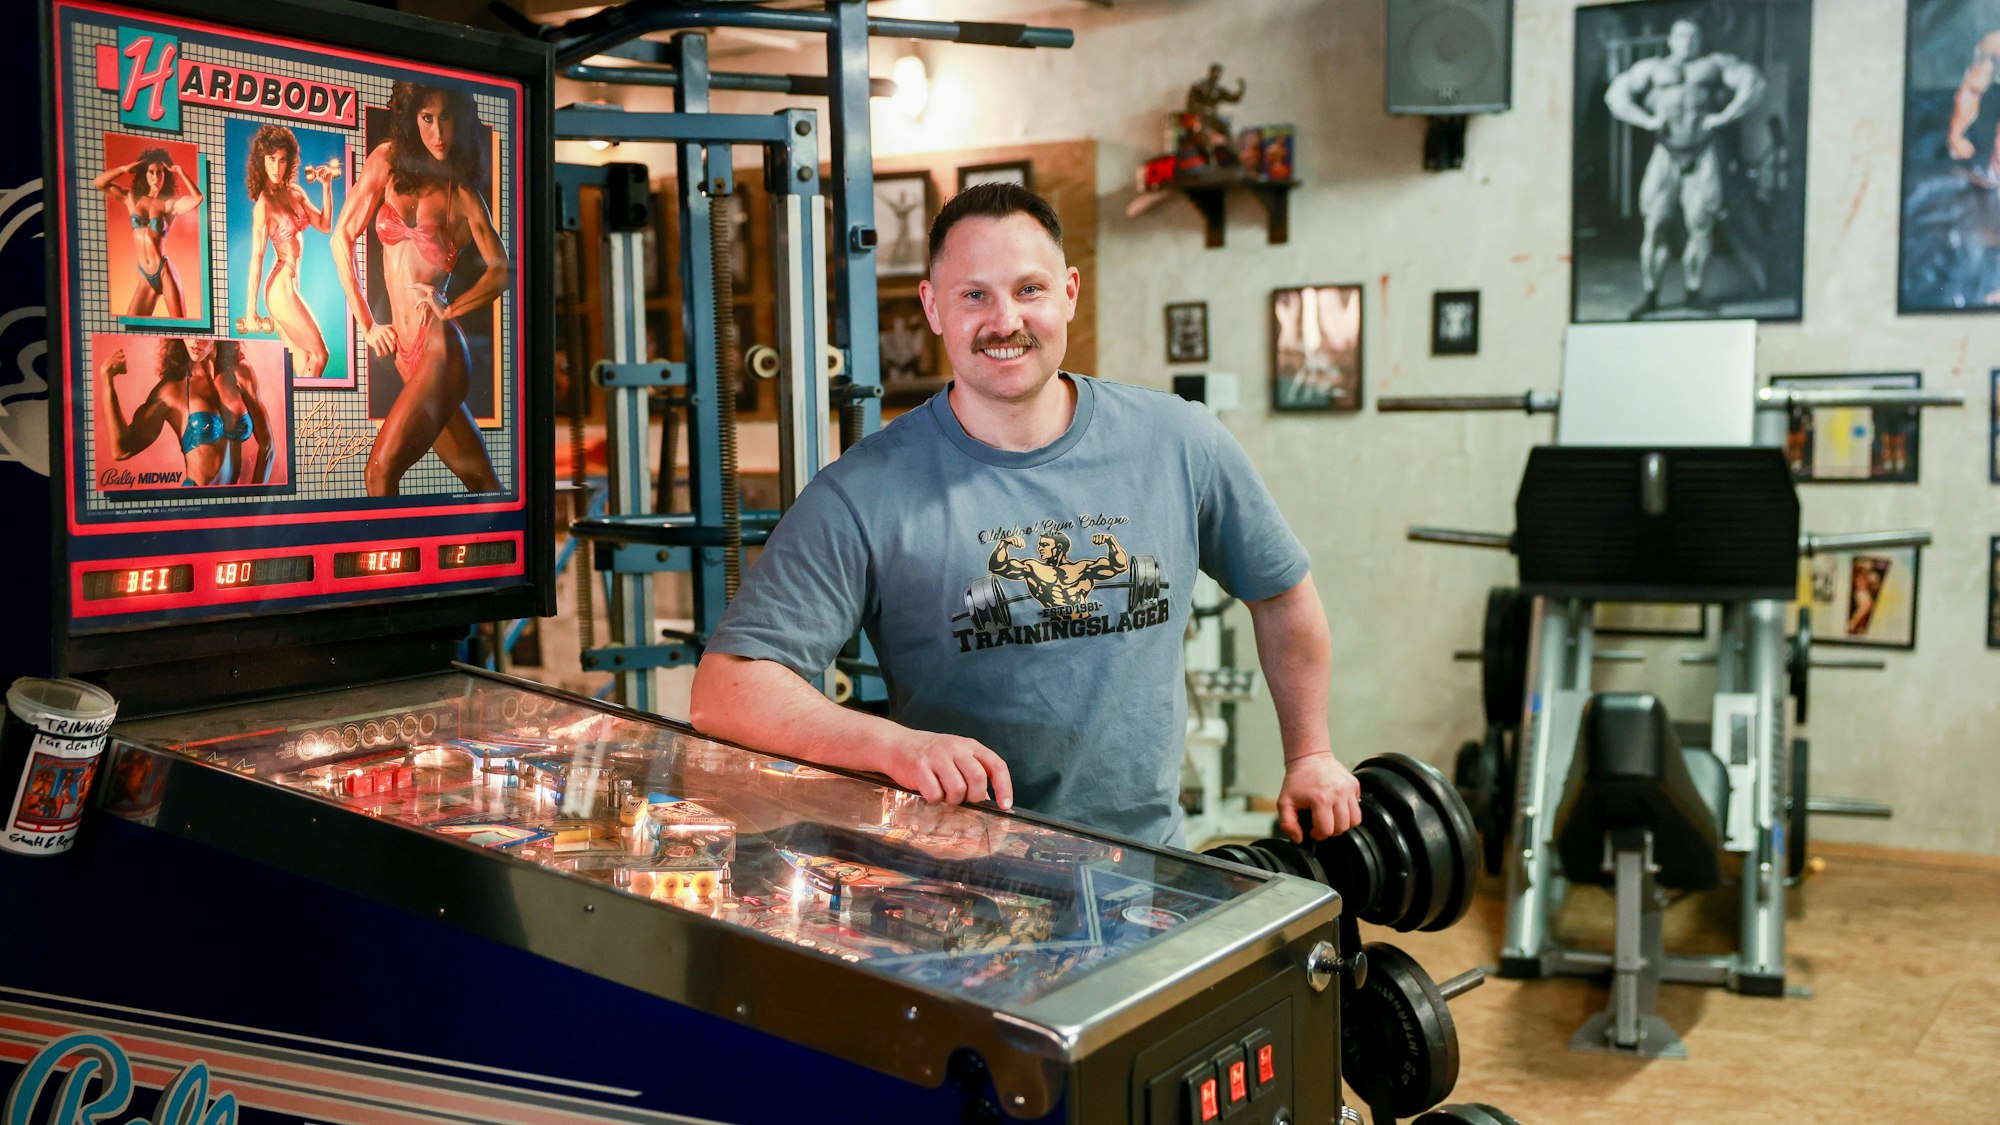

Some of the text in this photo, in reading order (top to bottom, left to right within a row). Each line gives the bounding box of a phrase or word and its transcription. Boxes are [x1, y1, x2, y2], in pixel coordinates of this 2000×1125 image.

[101, 468, 183, 488] Bally MIDWAY
[978, 513, 1129, 544] Oldschool Gym Cologne
[457, 546, 466, 564] 2
